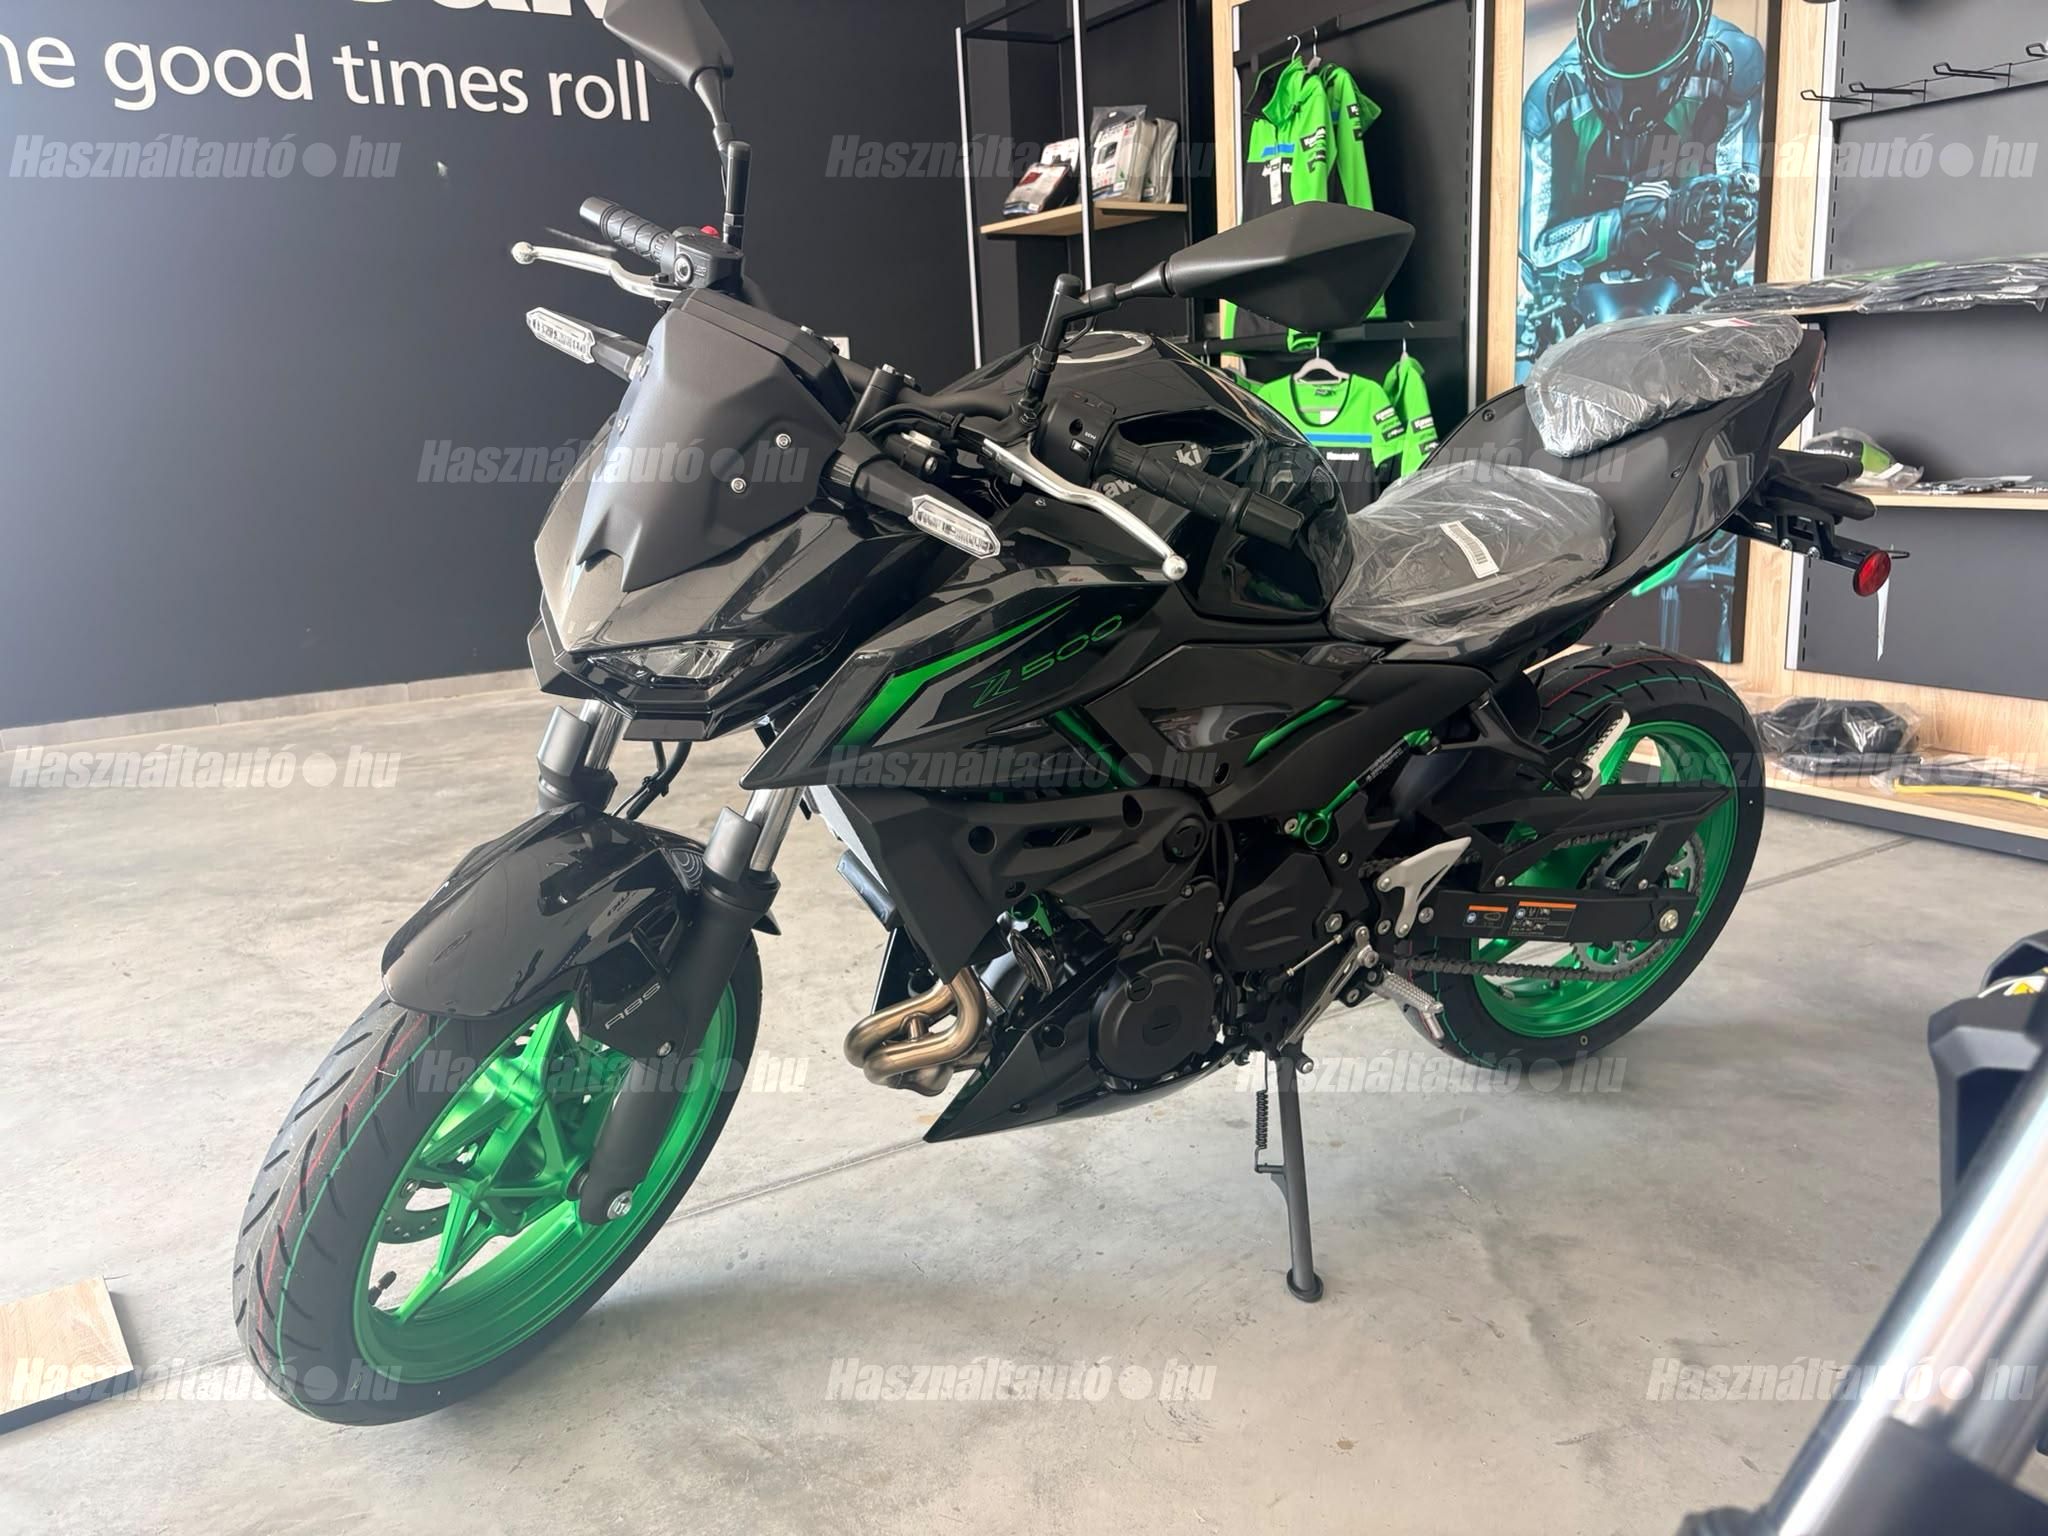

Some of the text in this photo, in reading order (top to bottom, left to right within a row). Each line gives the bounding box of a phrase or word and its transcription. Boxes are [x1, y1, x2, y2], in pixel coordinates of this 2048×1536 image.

[104, 35, 312, 110] good
[333, 40, 528, 115] times
[548, 58, 650, 122] roll
[605, 982, 661, 1030] ABS
